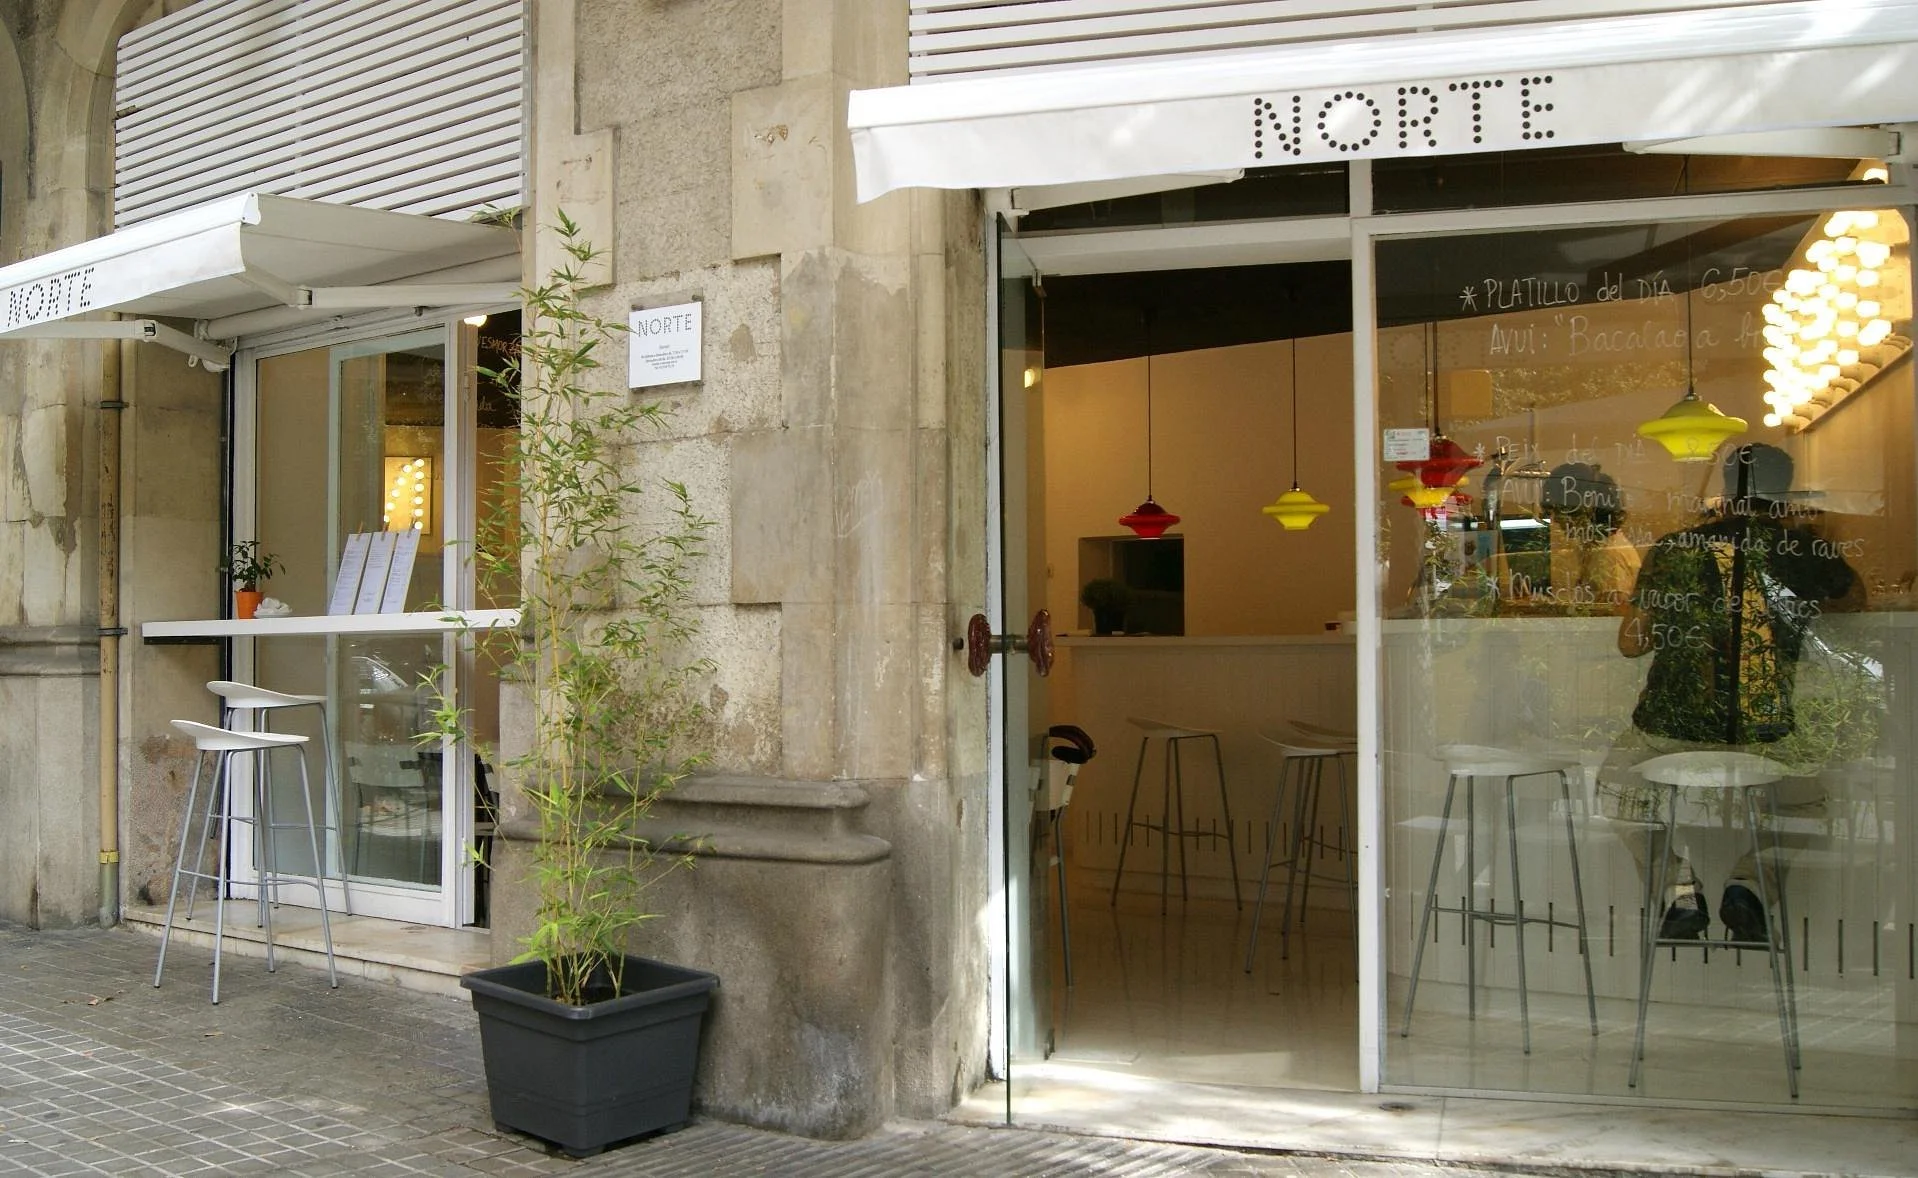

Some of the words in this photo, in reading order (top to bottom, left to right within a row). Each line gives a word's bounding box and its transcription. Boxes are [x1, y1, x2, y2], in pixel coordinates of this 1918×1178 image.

[1254, 75, 1555, 160] NORTE
[8, 267, 95, 327] NORTE
[1484, 277, 1580, 309] PLATILLO
[1597, 271, 1623, 302] del
[1701, 267, 1783, 302] 6,50€
[638, 313, 692, 337] NORTE
[1777, 528, 1803, 557] de
